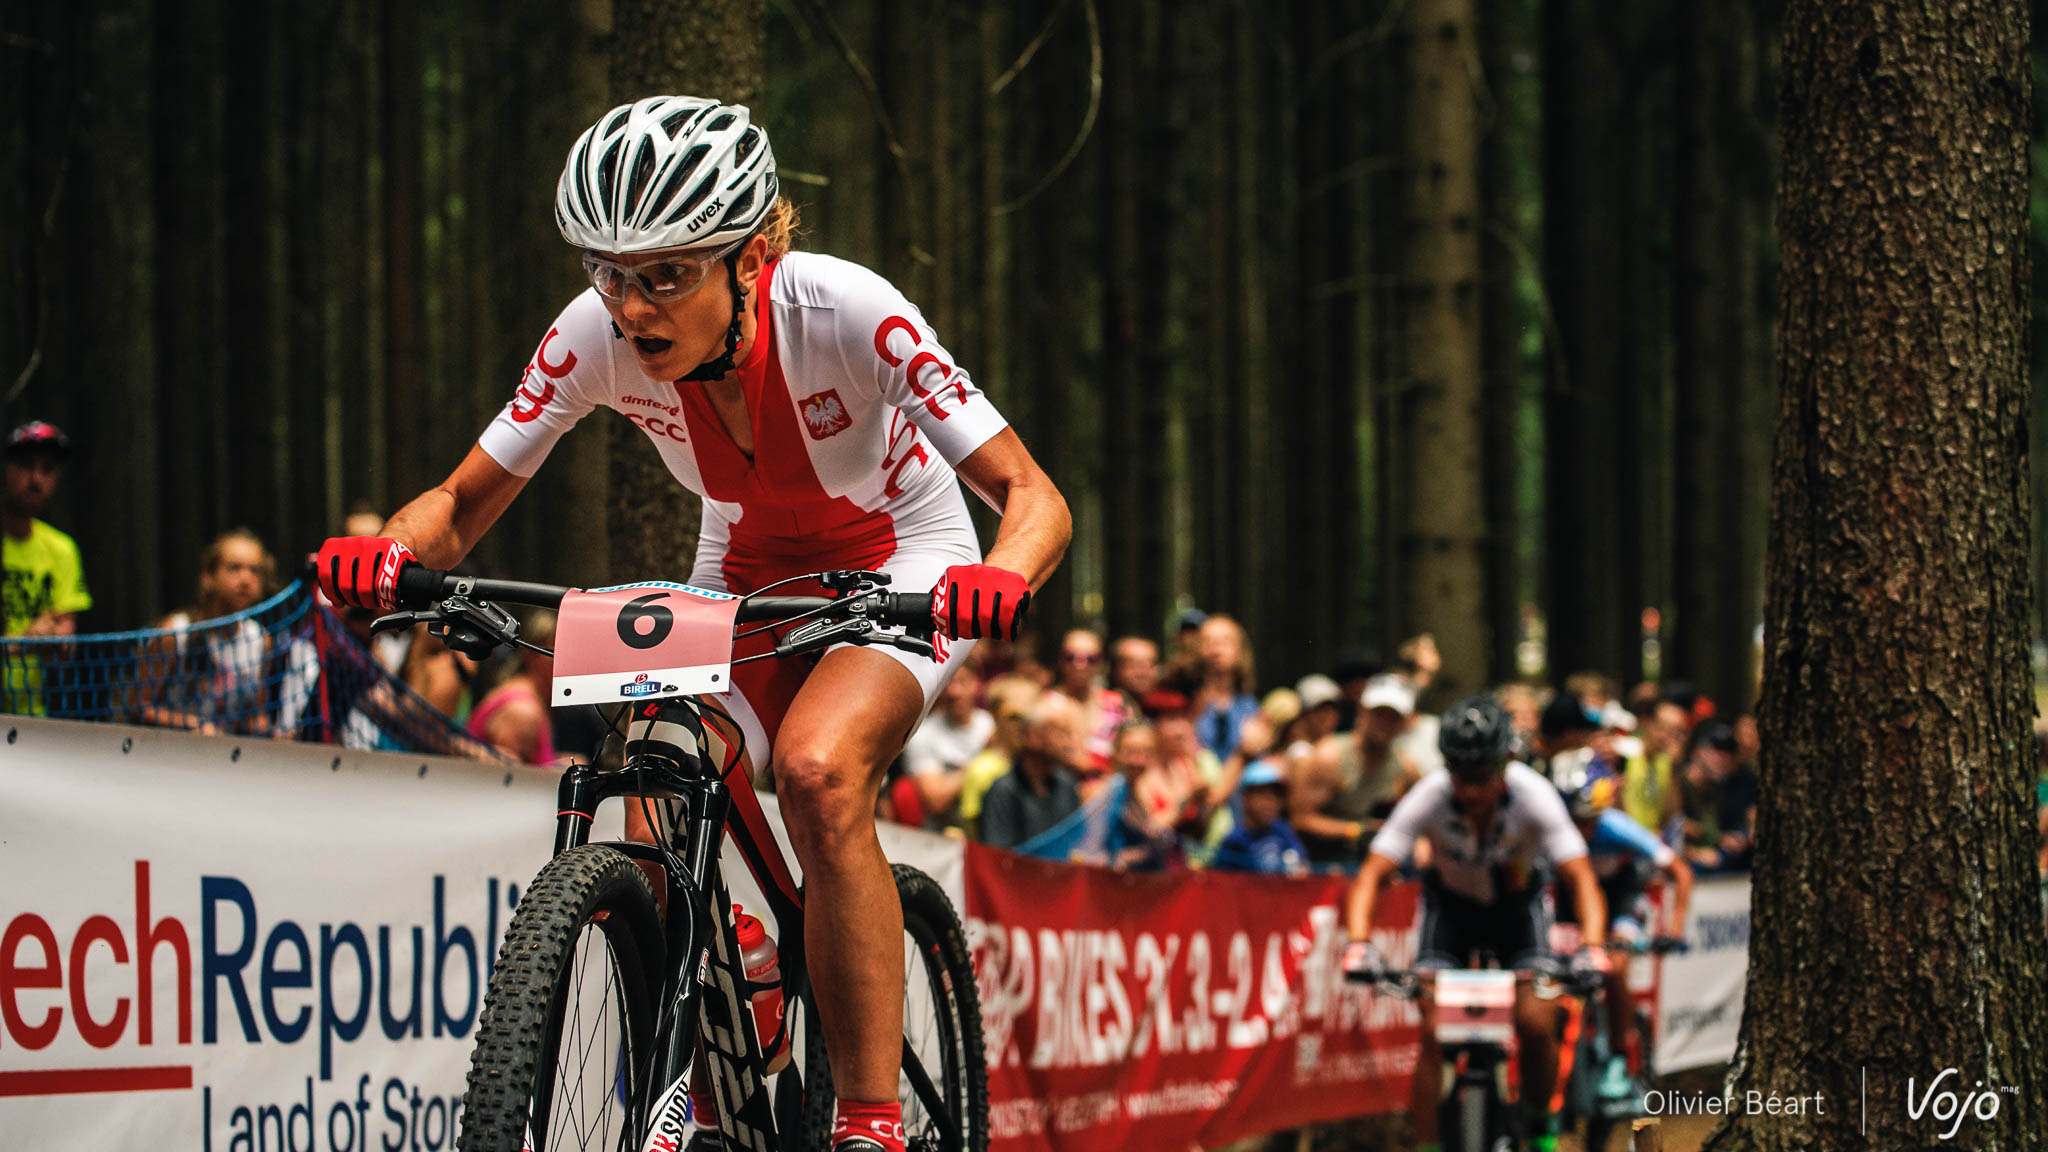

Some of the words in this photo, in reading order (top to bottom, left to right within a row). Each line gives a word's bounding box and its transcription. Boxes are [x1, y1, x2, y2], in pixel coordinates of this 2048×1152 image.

[686, 196, 725, 233] uvex
[621, 395, 671, 413] dmtex
[617, 592, 674, 650] 6
[624, 684, 658, 695] BIRELL
[328, 1074, 371, 1152] of
[382, 1077, 464, 1152] Stor
